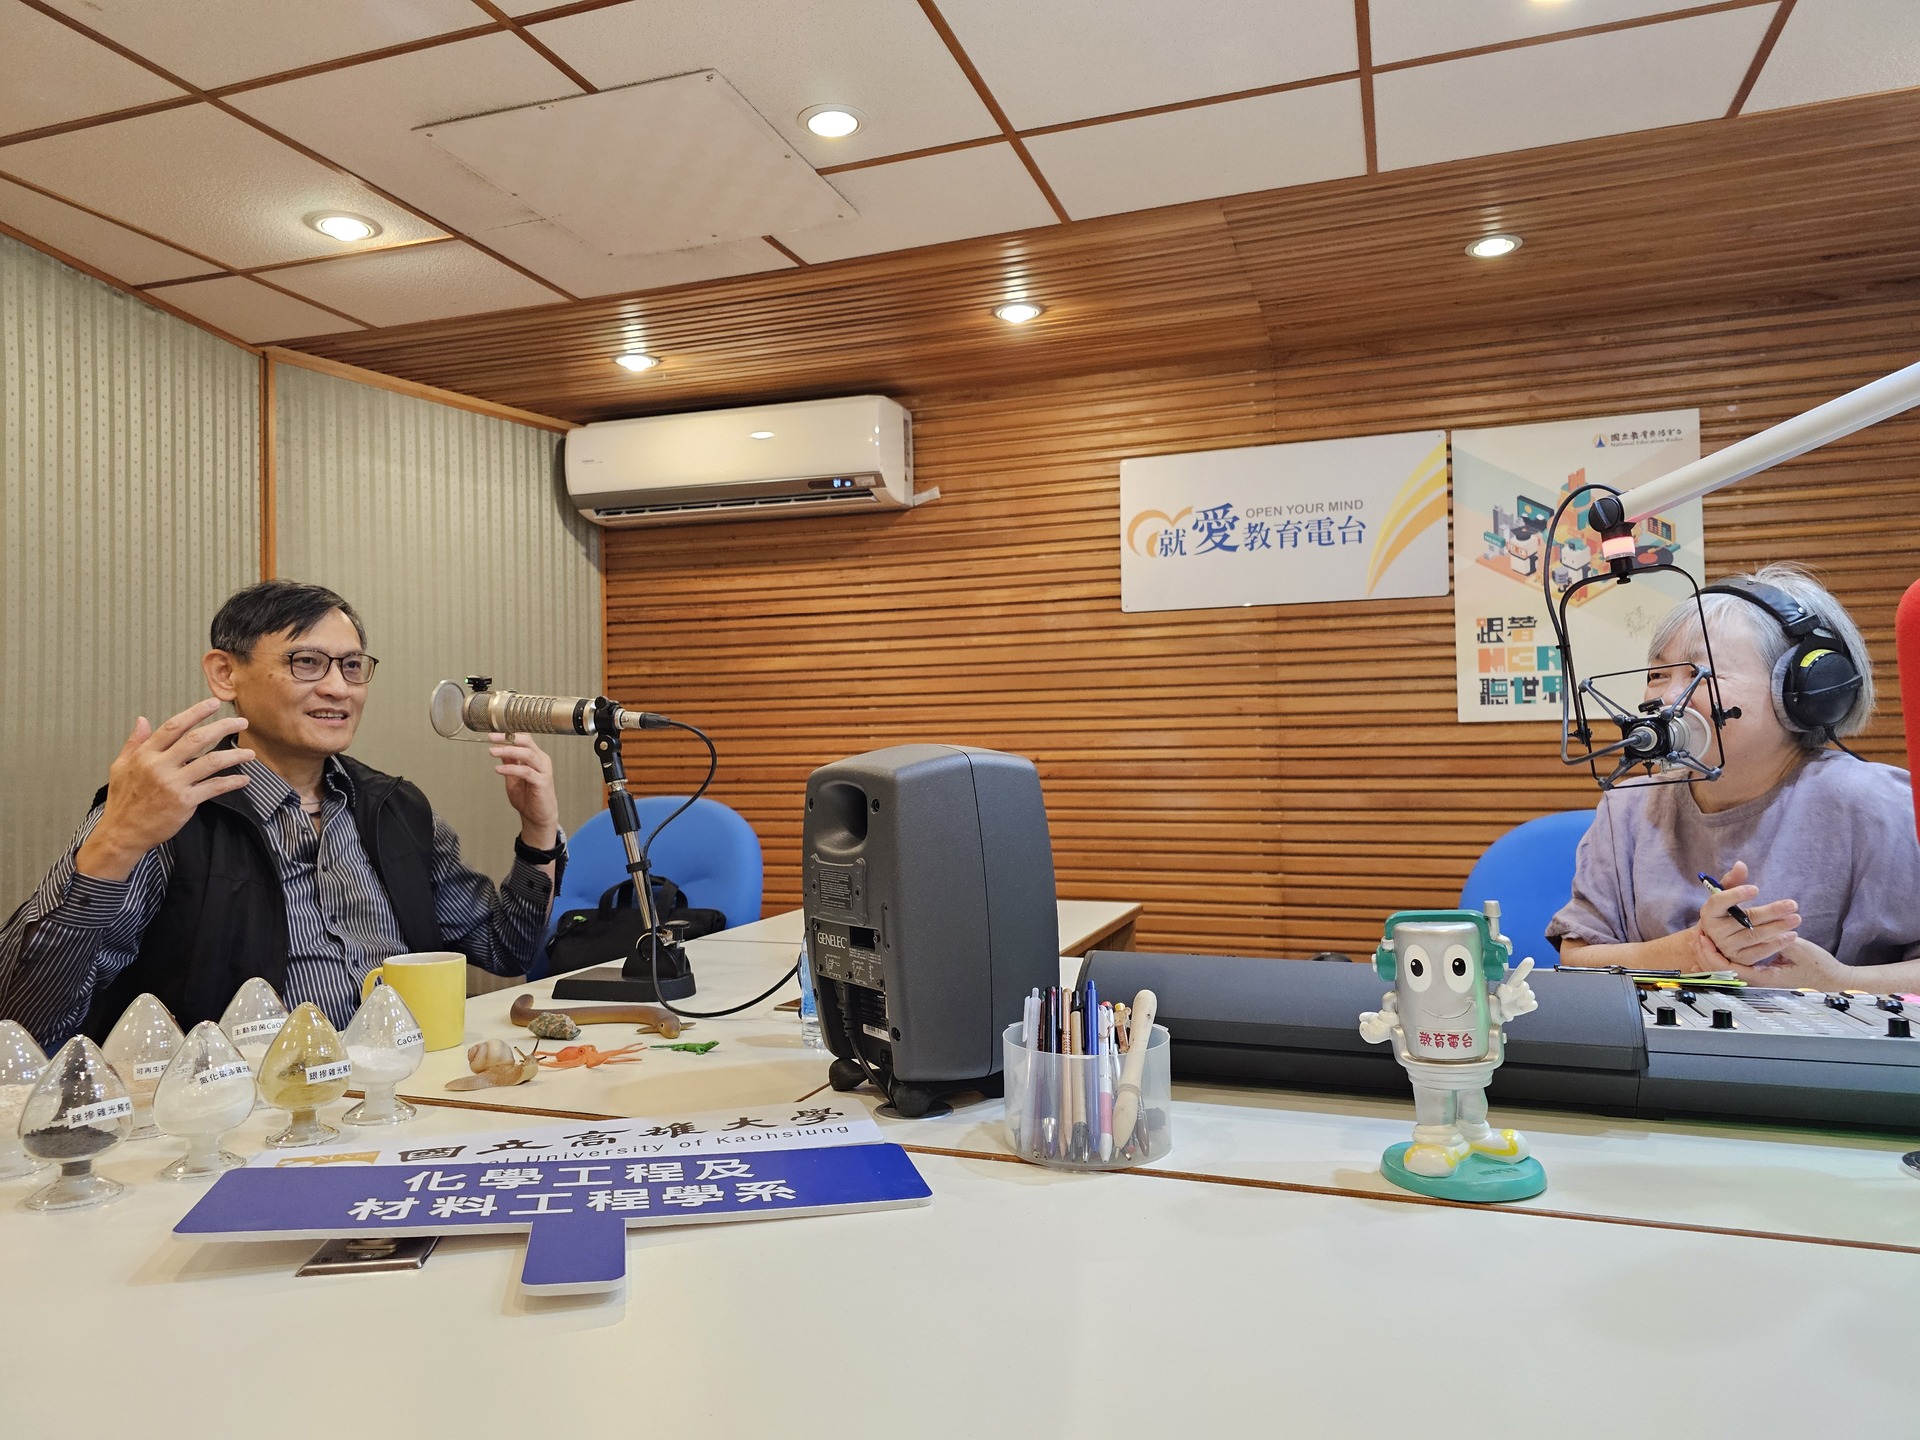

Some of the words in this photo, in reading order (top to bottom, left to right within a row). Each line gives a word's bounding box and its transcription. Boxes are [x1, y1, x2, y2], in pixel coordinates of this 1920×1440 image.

[1246, 506, 1282, 519] OPEN
[1286, 503, 1324, 516] YOUR
[1328, 500, 1364, 511] MIND
[817, 932, 847, 948] GENELEC
[235, 1021, 284, 1036] 主動殺菌CaO
[1419, 1031, 1473, 1049] 教育電台
[398, 1107, 844, 1162] 國立高雄大學
[526, 1144, 664, 1163] University
[679, 1139, 702, 1149] of
[716, 1125, 849, 1145] Kaohsiung
[403, 1158, 755, 1192] 化學工程及
[347, 1179, 797, 1221] 材料工程學系
